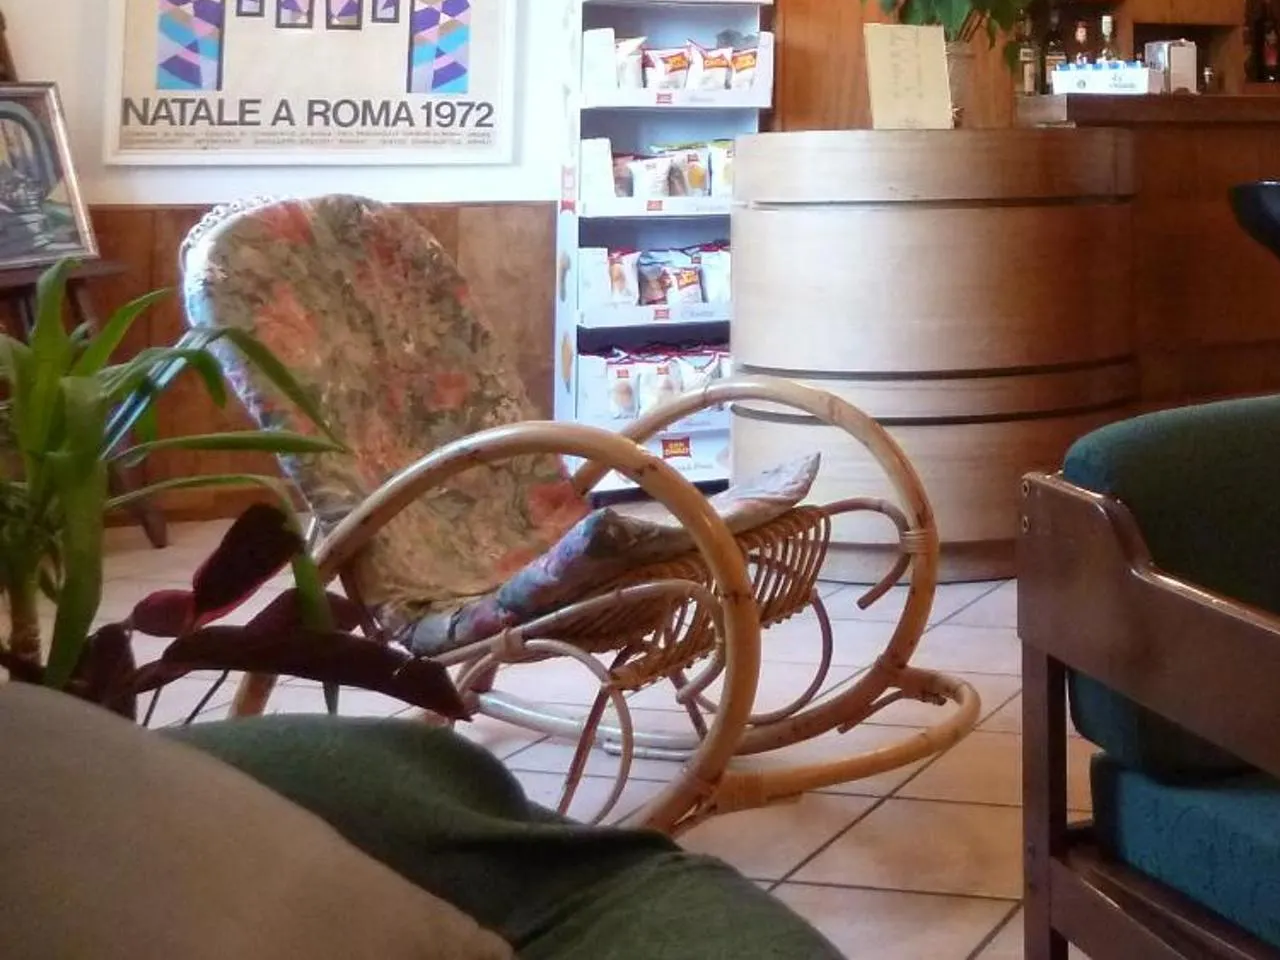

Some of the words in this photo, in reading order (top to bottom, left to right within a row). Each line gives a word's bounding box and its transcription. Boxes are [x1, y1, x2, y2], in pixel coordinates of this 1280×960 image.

[122, 97, 262, 127] NATALE
[271, 98, 295, 127] A
[307, 99, 415, 128] ROMA
[421, 100, 494, 128] 1972
